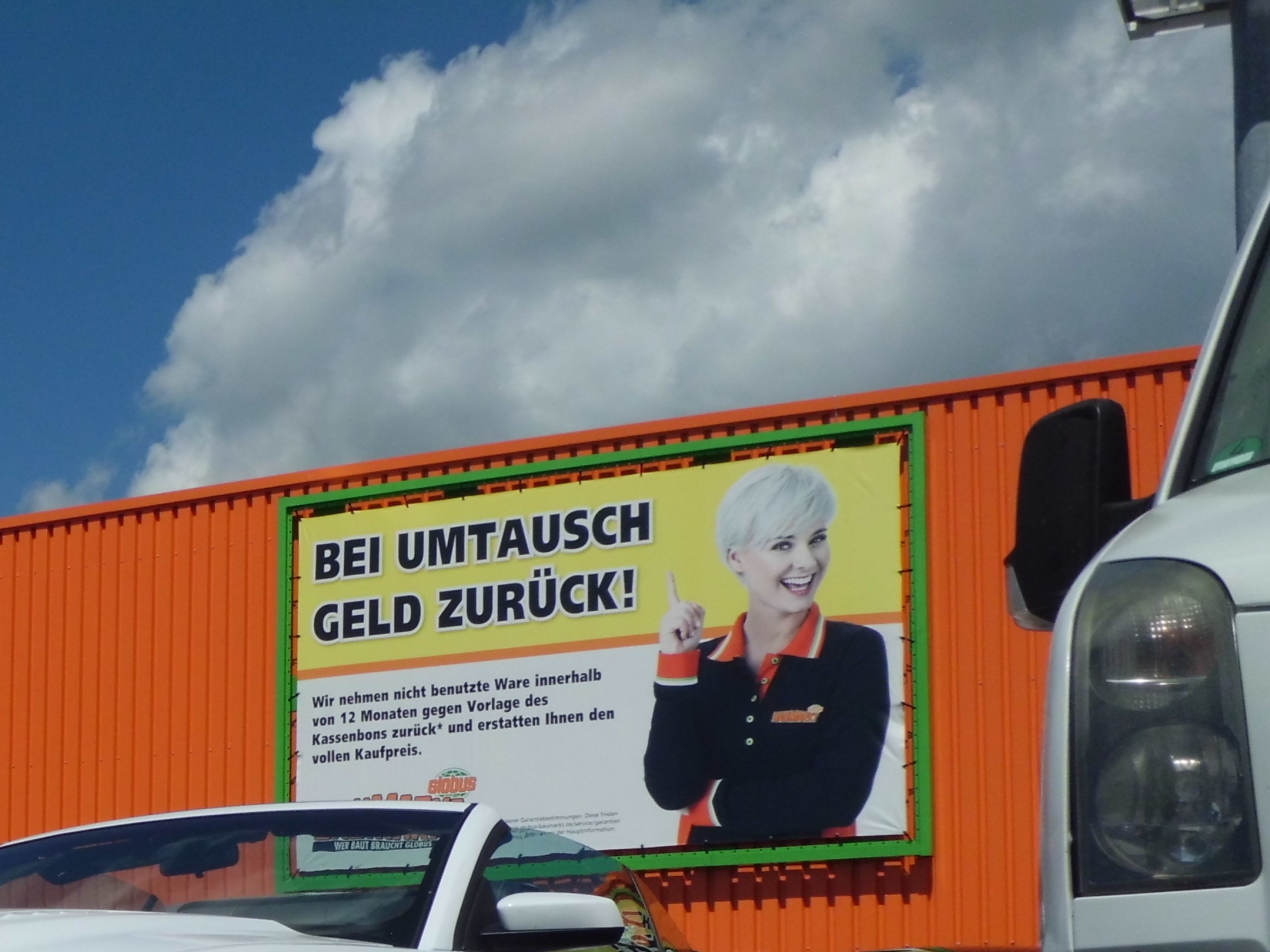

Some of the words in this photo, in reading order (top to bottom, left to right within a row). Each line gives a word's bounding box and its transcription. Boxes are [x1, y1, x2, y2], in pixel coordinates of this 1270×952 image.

[314, 536, 381, 582] BEI
[397, 501, 651, 570] UMTAUSCH
[313, 594, 422, 642] GELD
[438, 567, 634, 629] ZURÜCK!
[312, 694, 335, 708] Wir
[339, 691, 389, 706] nehmen
[394, 686, 426, 701] nicht
[431, 681, 490, 697] benutzte
[494, 678, 530, 691] Ware
[535, 668, 602, 687] innerhalb
[312, 715, 335, 727] von
[340, 711, 356, 724] 12
[361, 707, 417, 723] Monaten
[422, 704, 462, 720] gegen
[467, 698, 520, 713] Vorlage
[525, 694, 548, 707] des
[312, 729, 387, 746] Kassenbons
[448, 719, 473, 734] und
[478, 715, 540, 731] erstatten
[545, 711, 584, 725] Ihnen
[589, 707, 615, 721] den
[312, 750, 350, 764] vollen
[355, 743, 422, 761] Kaufpreis.
[334, 841, 349, 850] WER
[351, 840, 369, 850] BAUT
[370, 840, 404, 850] BRAUCHT
[405, 840, 433, 848] GLOBUS
